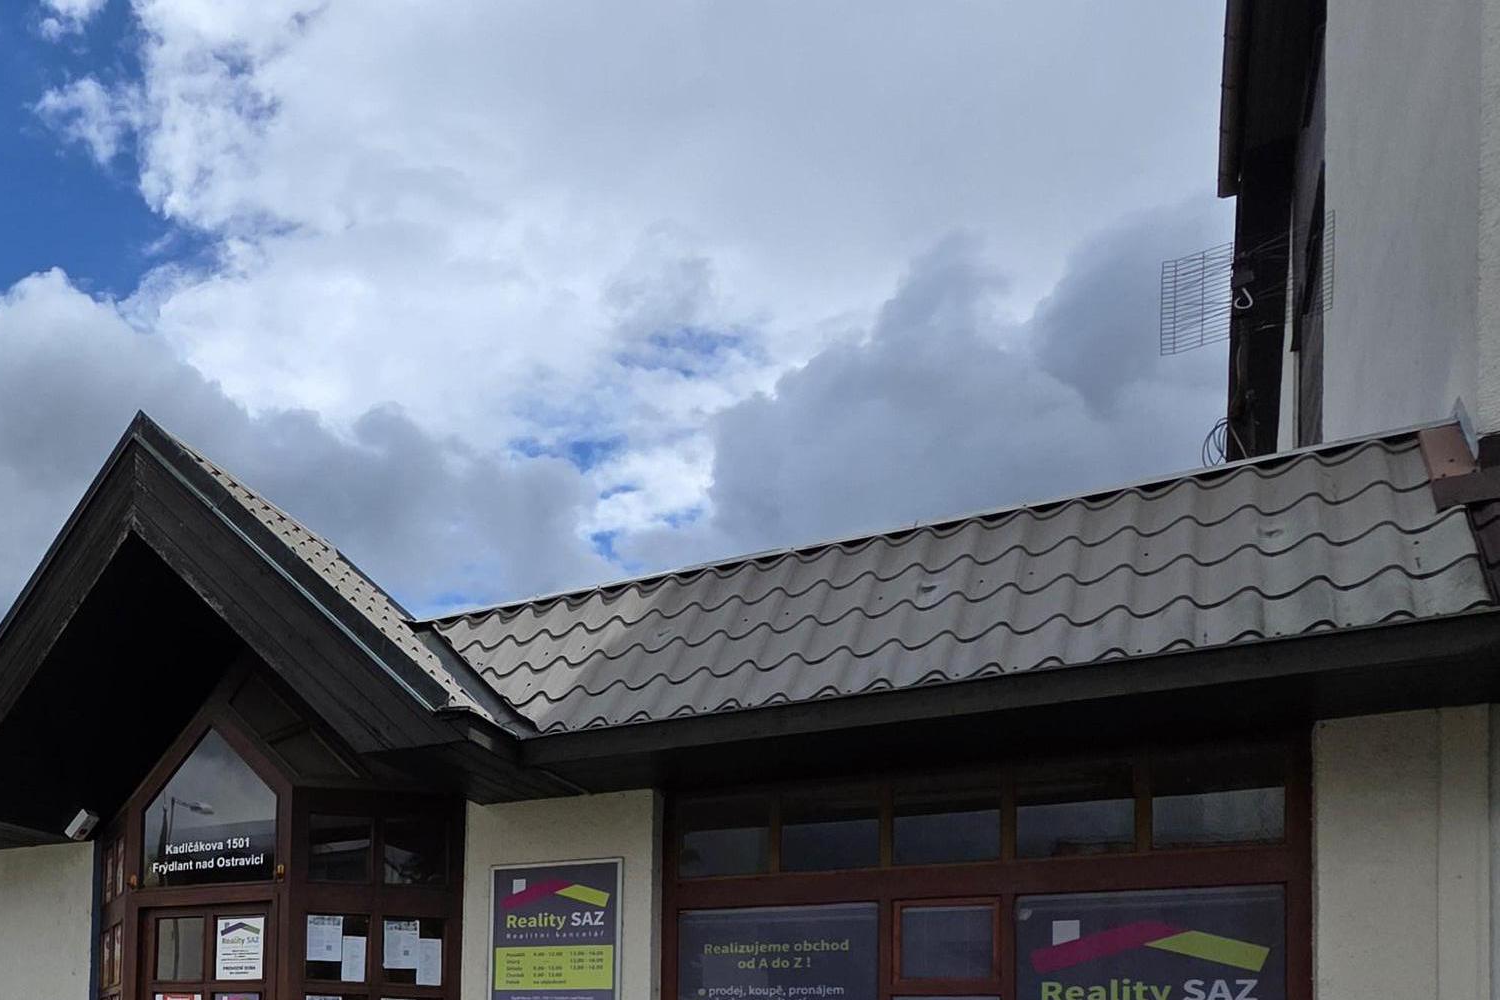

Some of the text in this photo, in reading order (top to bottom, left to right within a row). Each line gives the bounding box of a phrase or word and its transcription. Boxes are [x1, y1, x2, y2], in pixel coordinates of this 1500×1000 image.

[226, 837, 250, 849] 1501
[152, 853, 264, 875] Frýdlant nad Ostravicí
[506, 911, 605, 930] Reality SAZ
[704, 939, 850, 956] Realizujeme obchod
[738, 958, 756, 969] od
[758, 958, 769, 969] A
[771, 957, 790, 968] do
[793, 957, 803, 968] Z
[708, 984, 845, 997] prodej, koupě, pronájem
